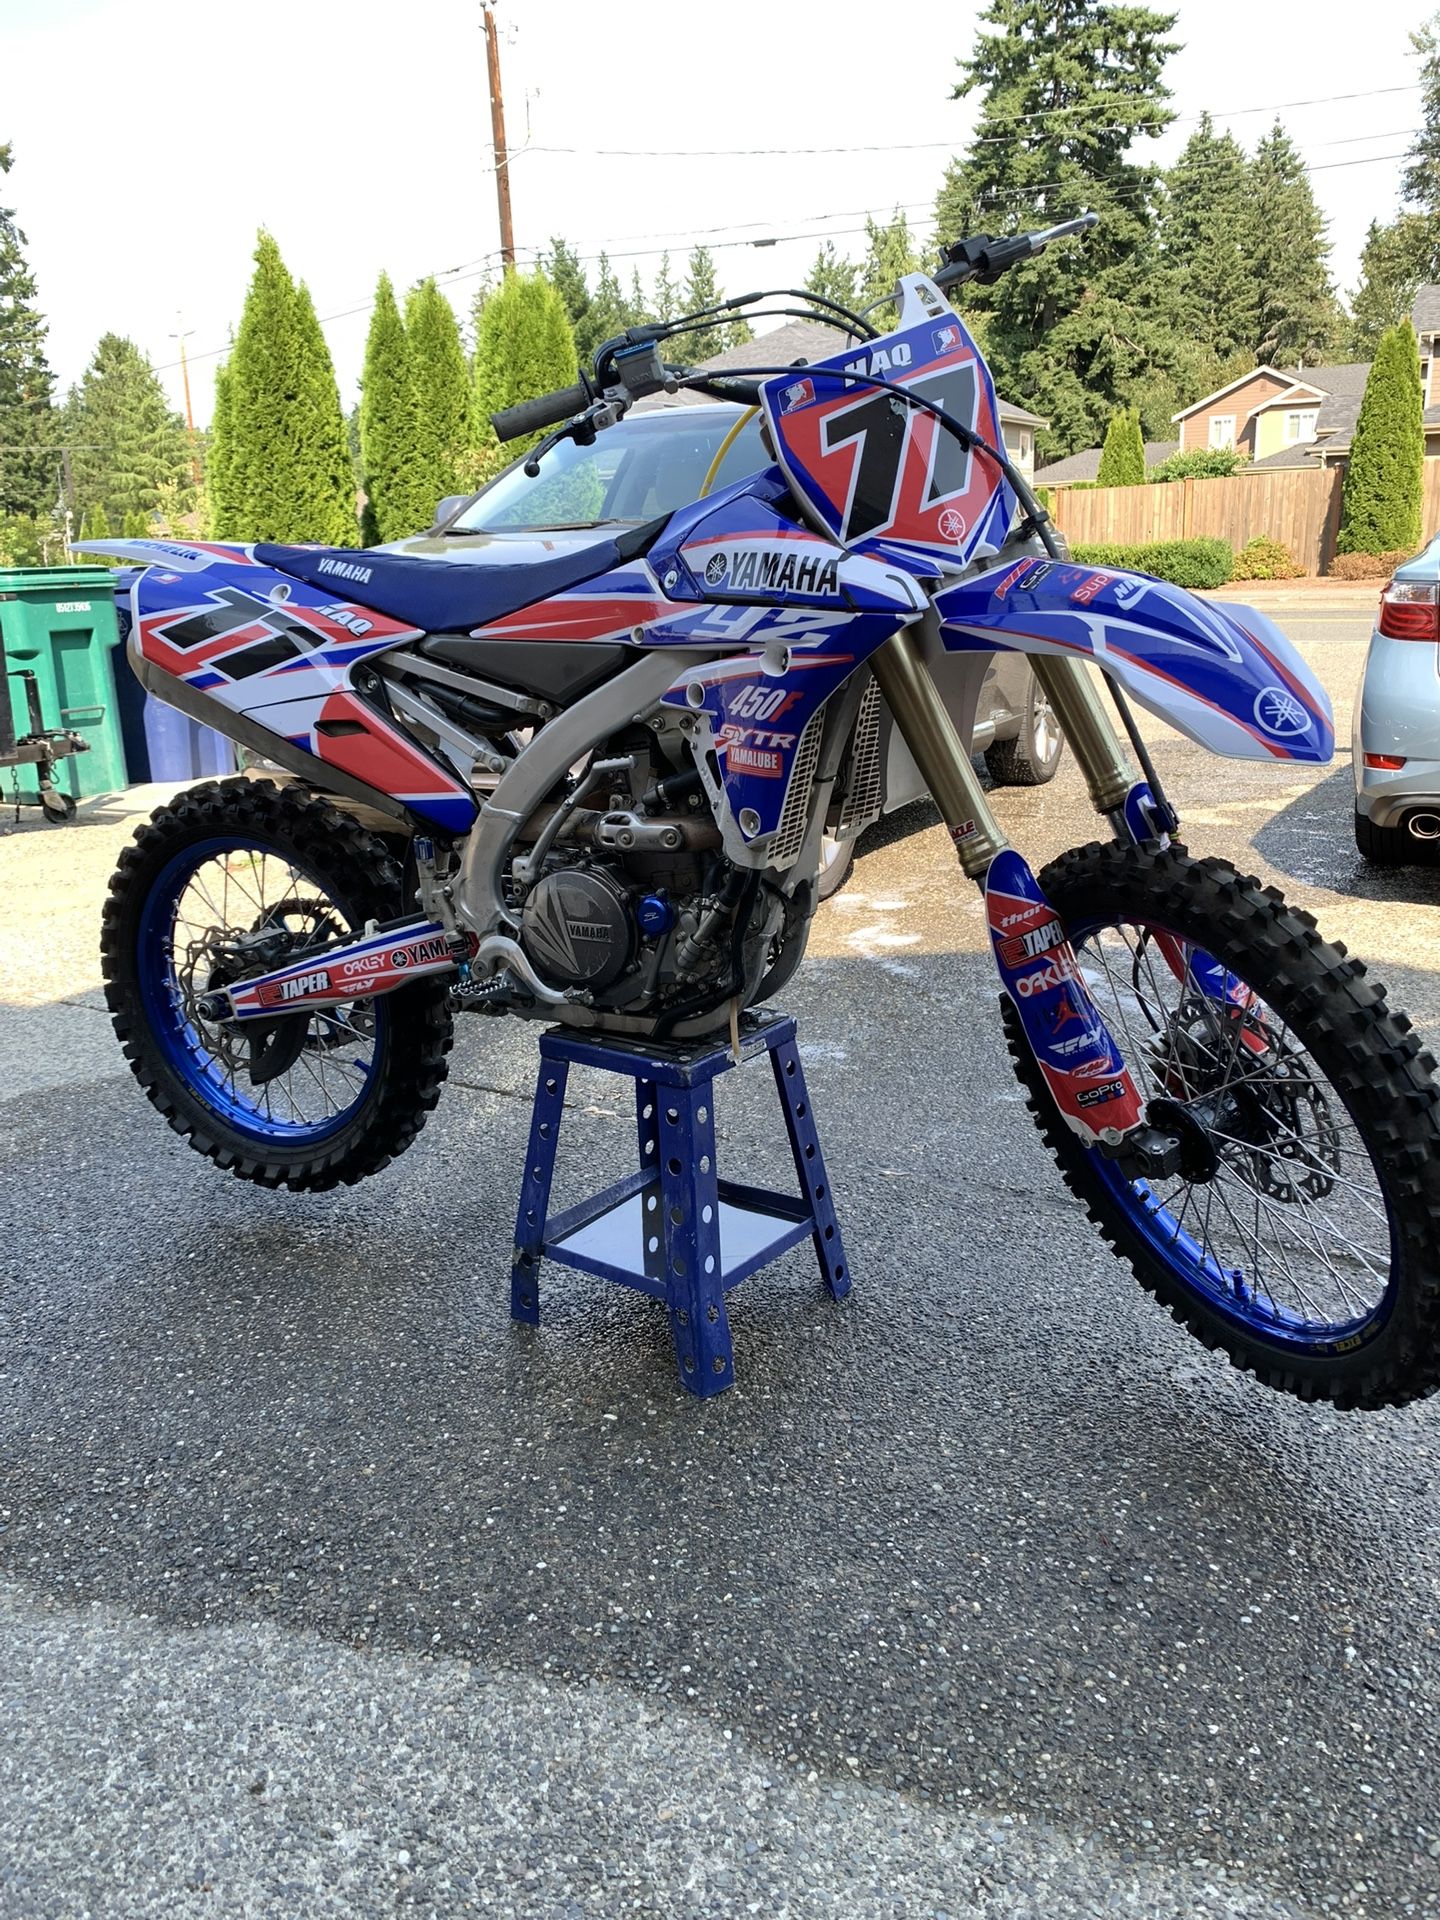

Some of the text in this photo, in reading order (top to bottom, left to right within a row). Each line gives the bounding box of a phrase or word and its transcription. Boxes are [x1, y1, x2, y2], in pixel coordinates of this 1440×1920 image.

[844, 343, 912, 388] HAQ
[317, 558, 373, 585] YAMAHA
[729, 551, 839, 594] YAMAHA
[727, 685, 805, 723] 450F
[719, 723, 797, 750] GYTR
[731, 747, 778, 769] YAMALUBE
[1000, 903, 1045, 928] thor
[569, 924, 610, 940] YAMAHA
[1023, 919, 1065, 957] TAPER
[343, 955, 386, 976] OAKLEY
[281, 971, 330, 1001] TAPER
[338, 978, 375, 994] FLY
[1047, 1024, 1102, 1055] FLY
[1076, 1081, 1123, 1102] GoPro
